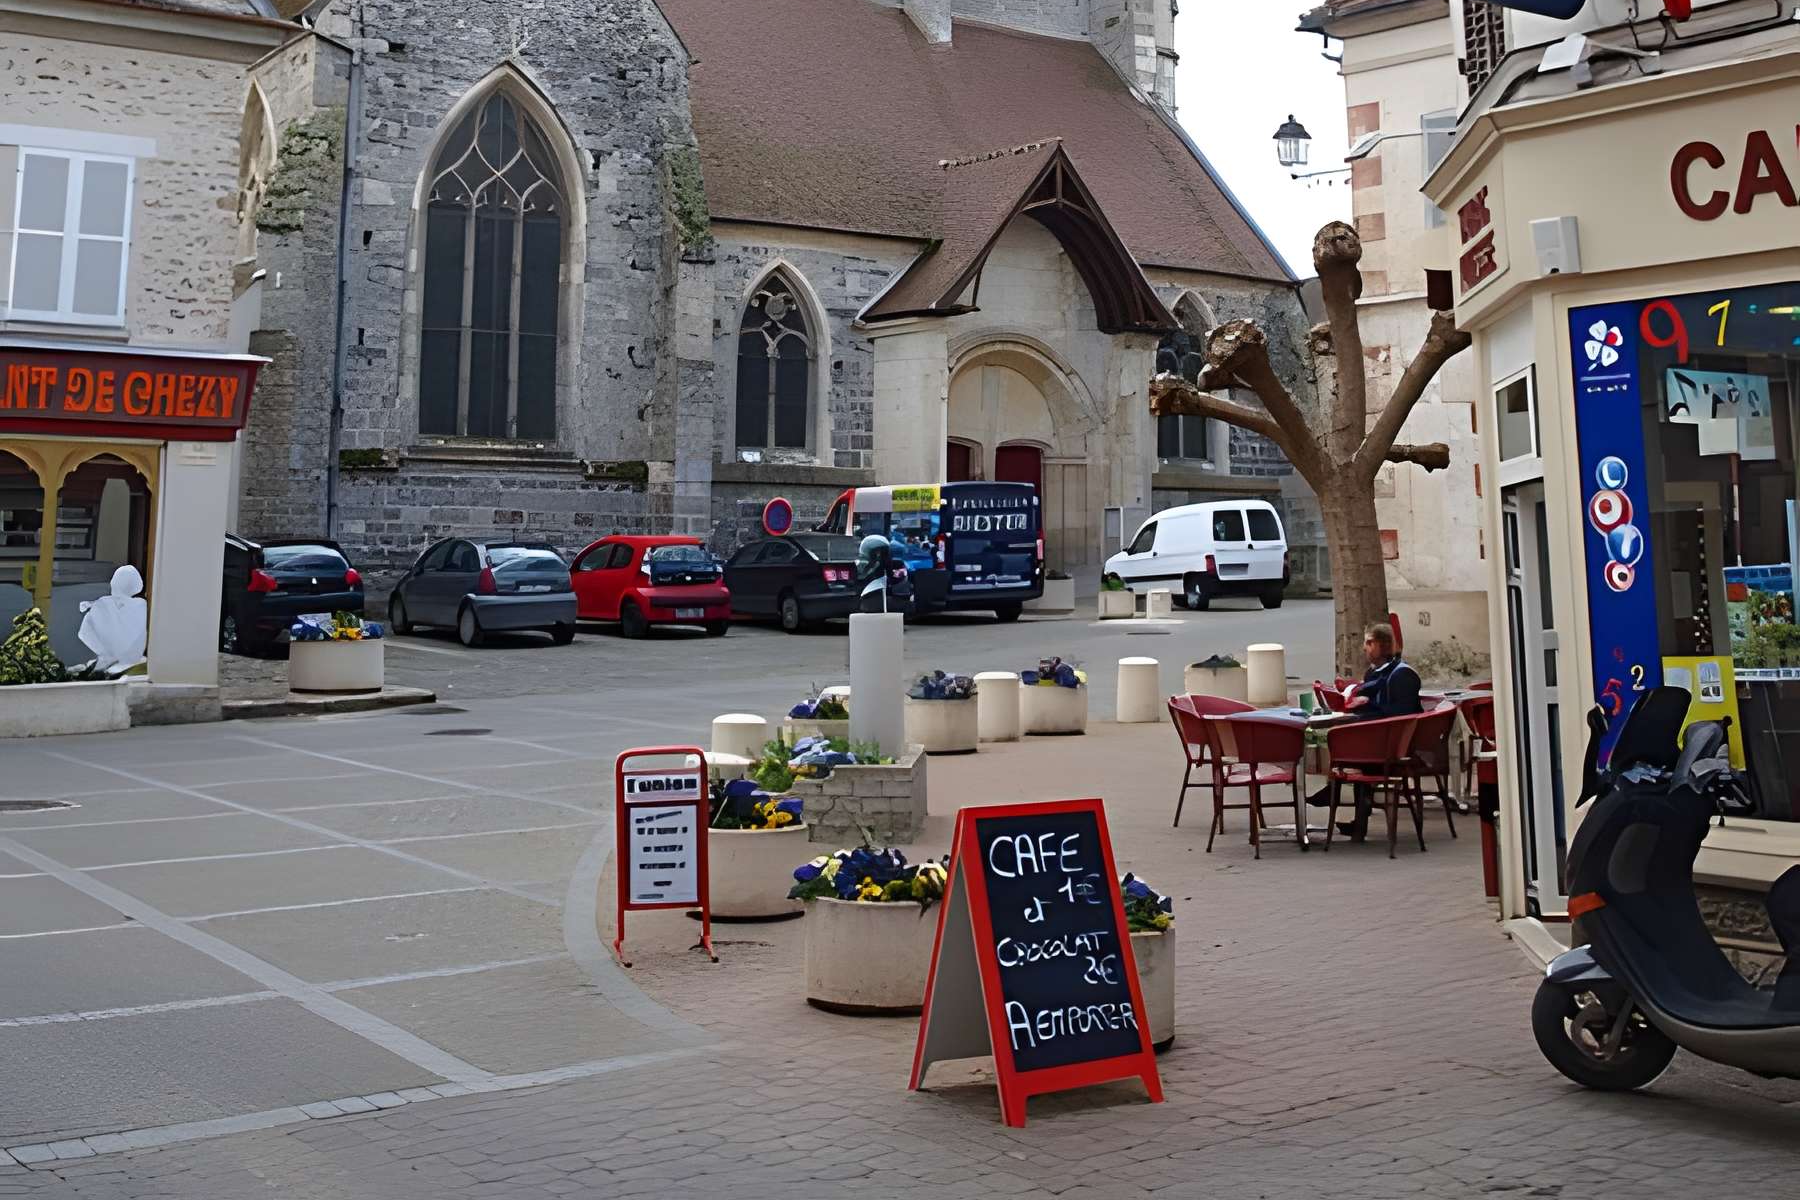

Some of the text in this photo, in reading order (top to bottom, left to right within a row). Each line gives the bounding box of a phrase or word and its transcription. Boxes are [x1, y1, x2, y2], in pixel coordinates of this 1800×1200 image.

[1670, 129, 1800, 222] CA
[64, 367, 115, 413] DE
[123, 371, 239, 418] CHEZY
